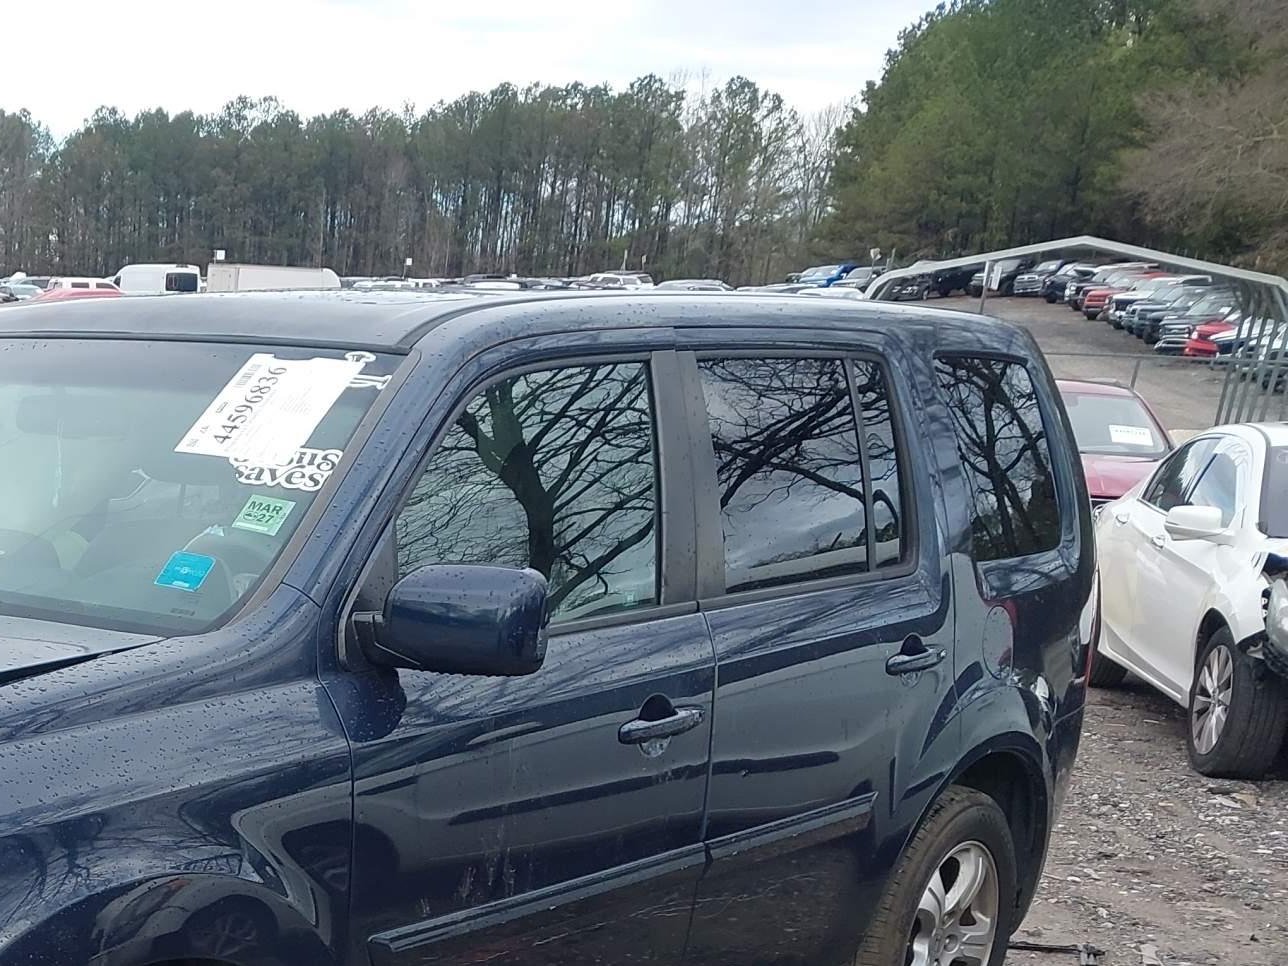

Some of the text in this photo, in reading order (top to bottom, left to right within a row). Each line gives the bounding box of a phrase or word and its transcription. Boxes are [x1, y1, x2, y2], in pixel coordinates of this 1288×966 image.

[213, 366, 288, 445] 44596836
[235, 464, 324, 488] saves
[248, 501, 283, 515] MAR
[256, 513, 274, 523] 27
